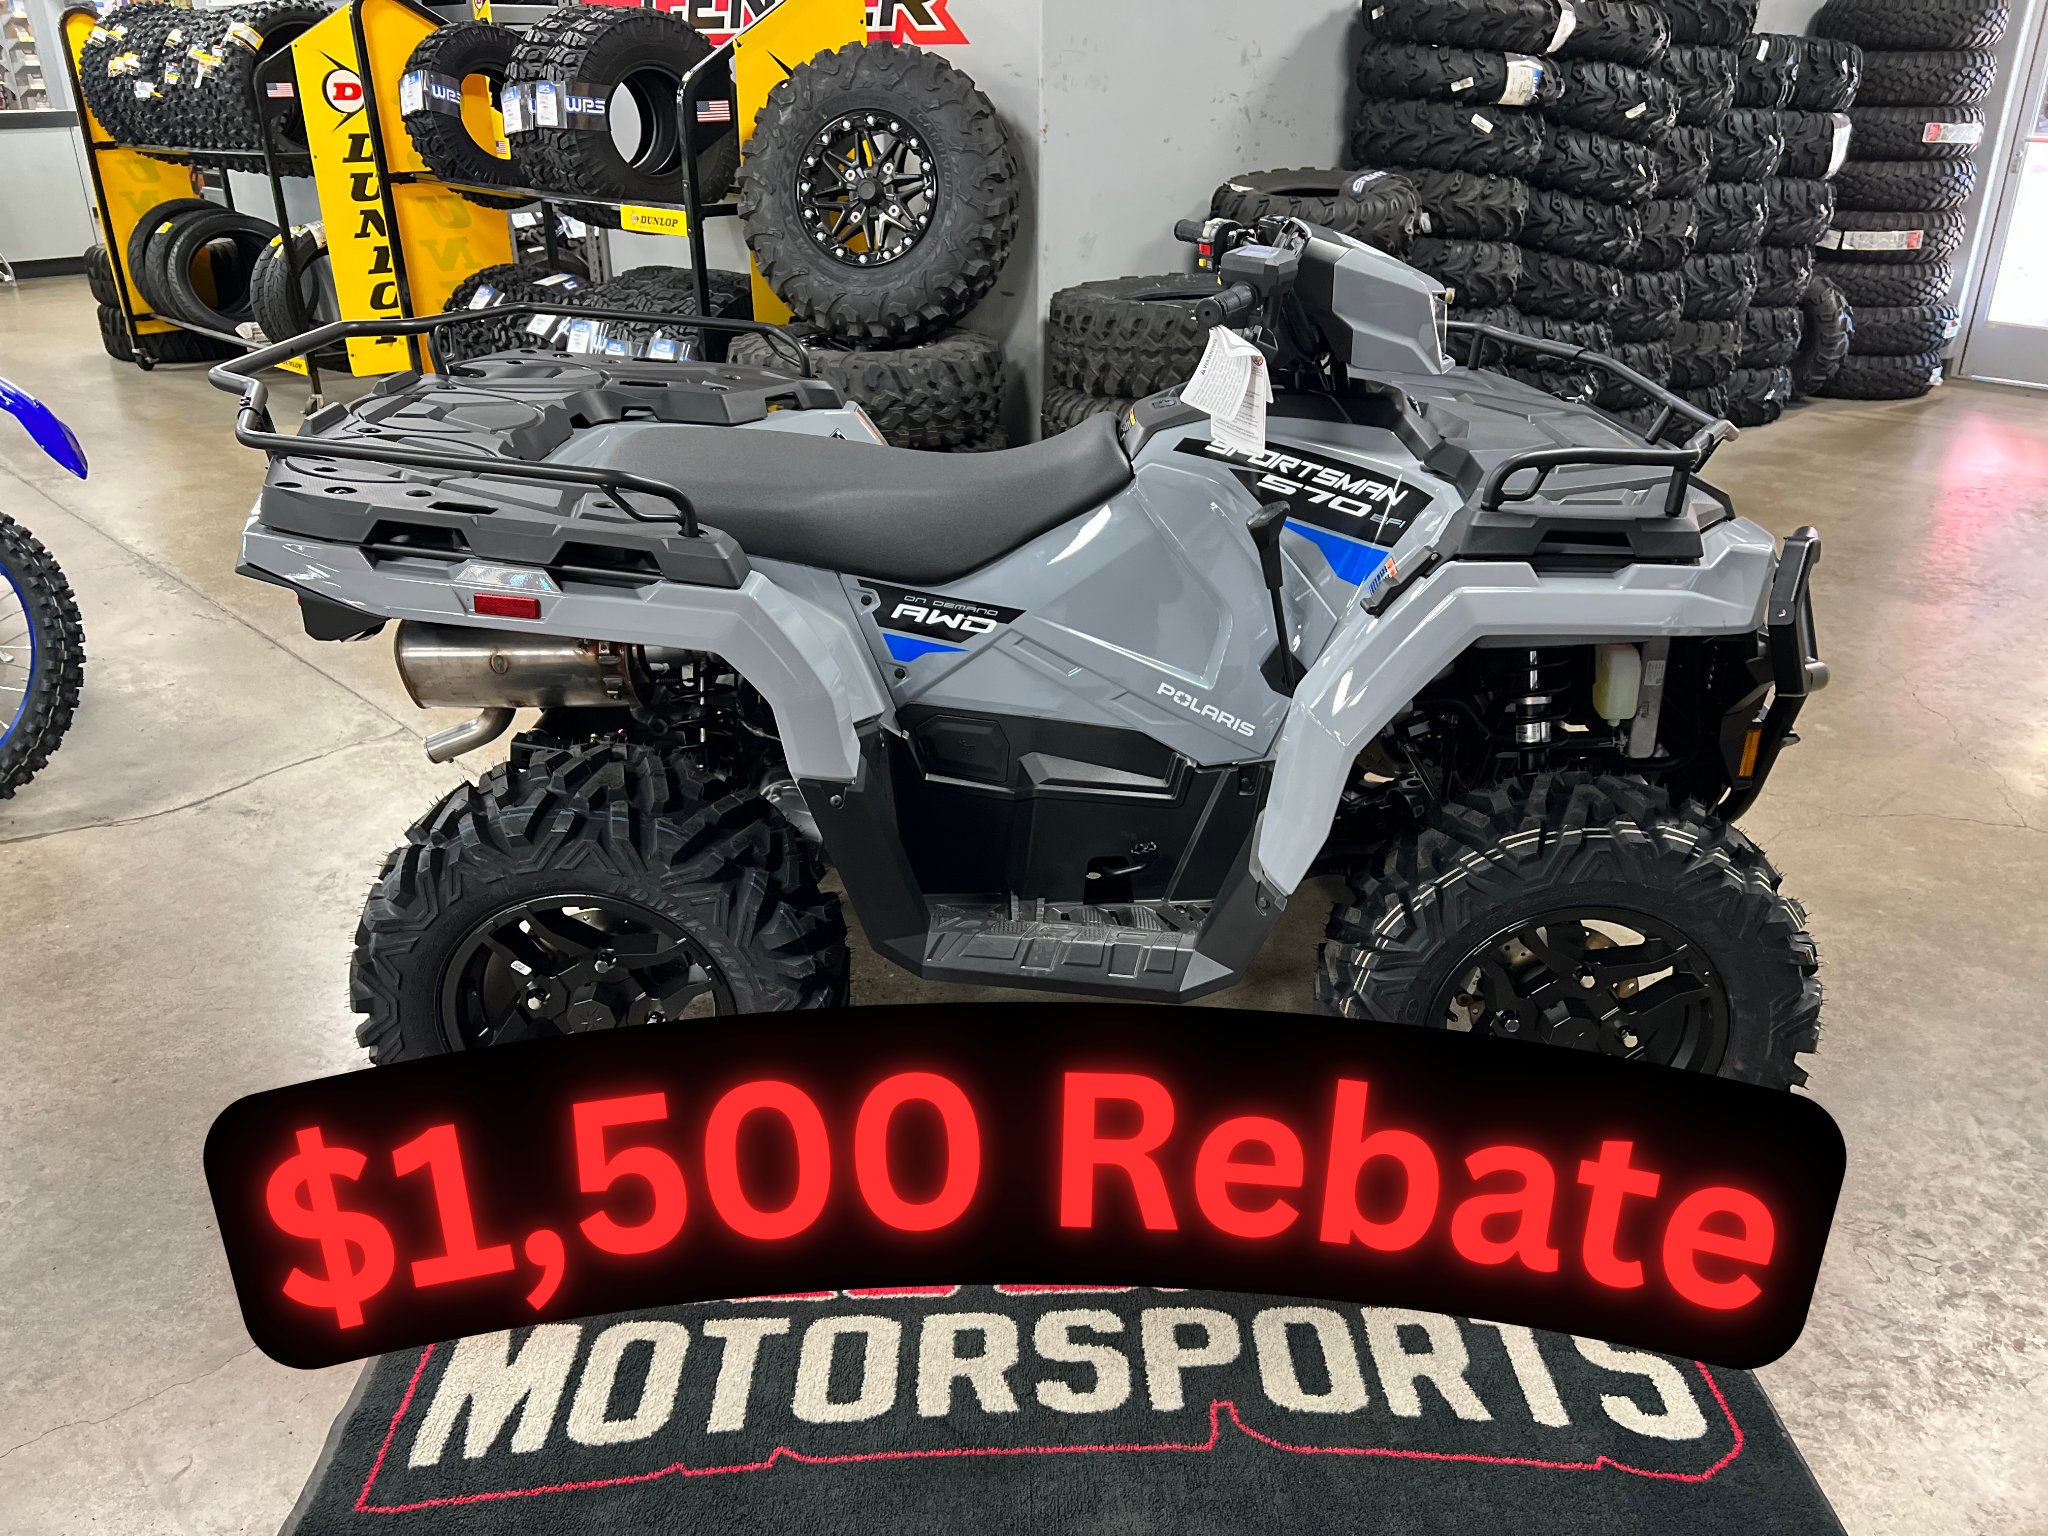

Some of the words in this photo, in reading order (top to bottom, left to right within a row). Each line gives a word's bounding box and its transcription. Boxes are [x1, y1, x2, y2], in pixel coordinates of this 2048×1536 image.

[332, 82, 363, 101] D
[565, 96, 606, 114] WPS
[640, 215, 678, 227] DUNLOP
[1256, 473, 1373, 518] 570
[1369, 512, 1407, 529] EFI
[890, 603, 998, 634] AWD
[903, 595, 927, 604] ON
[932, 600, 999, 616] DEMAND
[1156, 682, 1257, 738] POLARIS
[408, 1306, 1709, 1469] MOTORSPORTS
